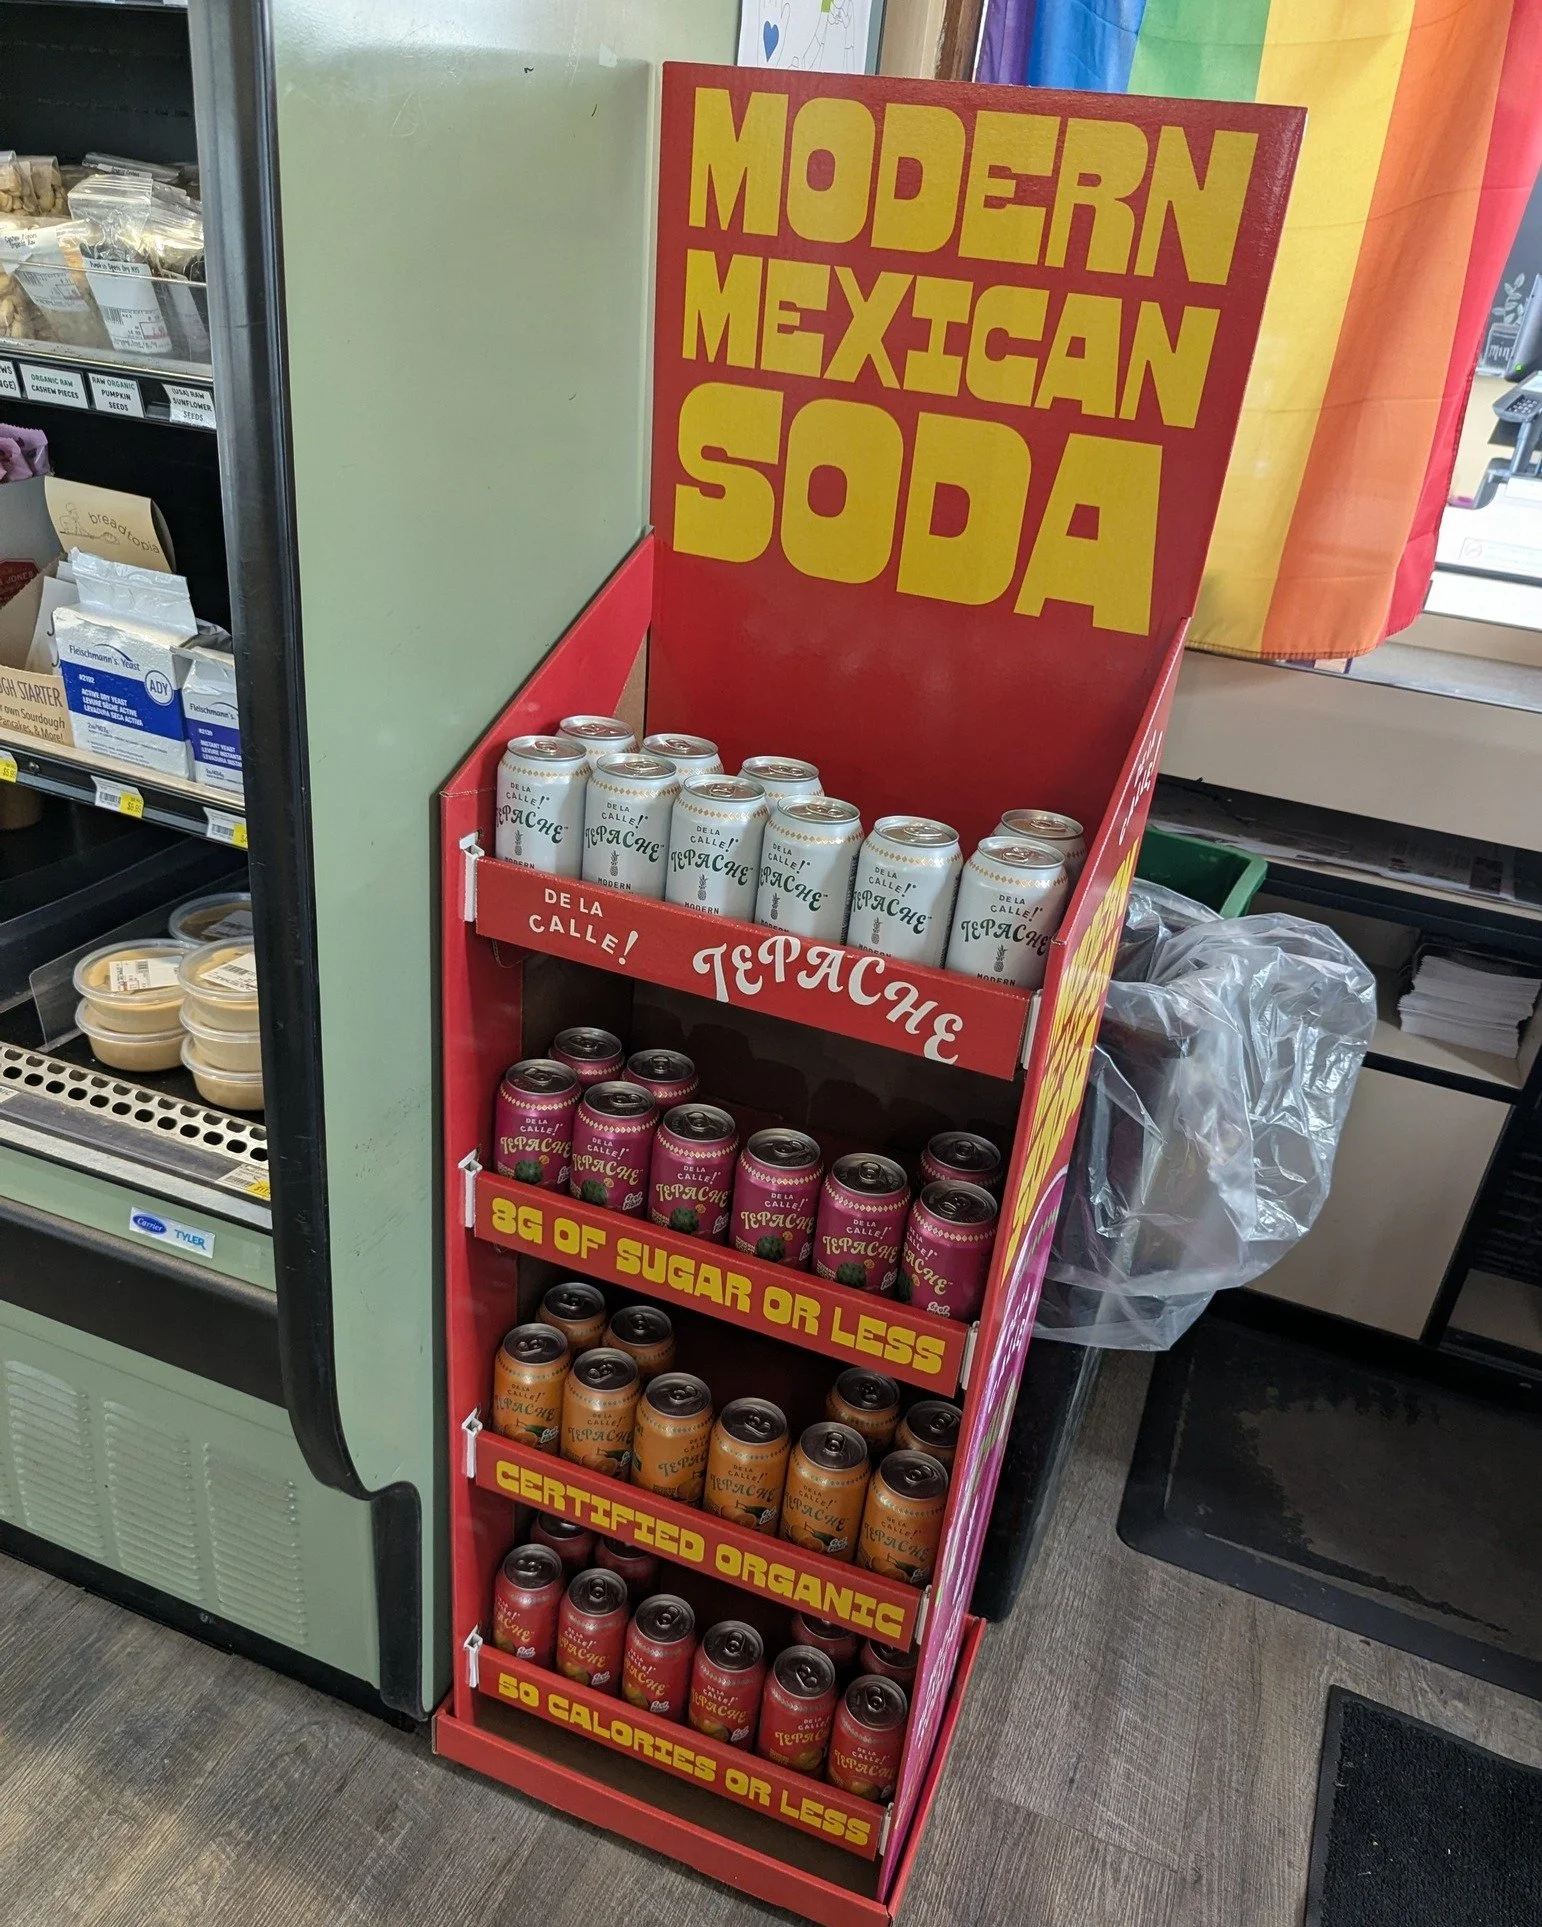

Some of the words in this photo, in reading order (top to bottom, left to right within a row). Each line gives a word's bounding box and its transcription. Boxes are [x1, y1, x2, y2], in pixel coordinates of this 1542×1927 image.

[688, 86, 1259, 286] MODERN
[681, 248, 1220, 429] MEXICAN
[31, 373, 59, 386] ORGANIC
[60, 378, 74, 388] RAW
[92, 376, 106, 386] RAW
[107, 378, 136, 391] ORGANIC
[31, 384, 57, 396] CASHEW
[57, 388, 80, 400] PIECES
[101, 389, 132, 402] PUMPKIN
[190, 390, 205, 400] RAW
[108, 401, 130, 412] SEEDS
[172, 397, 213, 412] SUNFLOWER
[183, 410, 205, 422] SEEDS
[673, 381, 1164, 637] SODA
[87, 511, 161, 555] breadtopia
[6, 570, 34, 584] JONES
[69, 644, 118, 666] Fleischmann's
[122, 658, 141, 672] Yeast
[17, 680, 63, 708] STARTER
[149, 679, 168, 696] ADY
[81, 688, 100, 699] ACTIVE
[100, 692, 111, 701] DRY
[111, 695, 128, 707] YEAST
[82, 696, 103, 708] LEVURE
[119, 706, 138, 718] ACTIVE
[83, 704, 110, 719] LEVADURA
[110, 712, 125, 721] SECA
[124, 715, 144, 727] ACTIVA
[189, 702, 236, 721] Fleischmann's
[4, 705, 20, 717] own
[20, 708, 65, 731] Sourdough
[33, 725, 41, 736] &
[41, 727, 64, 743] More!
[220, 743, 236, 753] YEAST
[510, 782, 520, 791] DE
[521, 785, 532, 793] LA
[505, 791, 546, 810] CALLE!
[606, 802, 618, 810] DE
[619, 805, 630, 813] LA
[601, 812, 644, 829] CALLE!
[696, 825, 708, 834] DE
[709, 828, 721, 836] LA
[585, 825, 660, 863] TEPACHE
[690, 835, 735, 853] CALLE!
[772, 842, 781, 852] DE
[783, 847, 792, 856] LA
[504, 856, 536, 869] MODERN
[670, 848, 749, 886] TEPACHE
[767, 852, 806, 875] CALLE!
[874, 866, 885, 876] DE
[887, 870, 898, 880] LA
[597, 877, 632, 890] MODERN
[759, 866, 822, 912] EPACHE
[868, 876, 912, 898] CALLE!
[544, 887, 572, 909] DE
[579, 897, 604, 918] LA
[684, 901, 720, 915] MODERN
[998, 894, 1012, 903] DE
[1014, 897, 1026, 905] LA
[852, 889, 926, 935] TEPACHE
[990, 904, 1039, 922] CALLE!
[528, 914, 639, 965] CALLE!
[960, 918, 1049, 957] TEPACHE
[976, 972, 1016, 987] MODERN
[692, 934, 965, 1066] TEPACHE
[519, 1123, 560, 1136] CALLE!
[525, 1117, 536, 1125] DE
[500, 1135, 572, 1159] TEPACHE
[592, 1136, 602, 1145] DE
[587, 1144, 626, 1160] CALLE!
[571, 1153, 640, 1186] TEPACHE
[677, 1171, 718, 1185] CALLE!
[655, 1183, 729, 1208] TEPACHE
[771, 1192, 782, 1200] DE
[764, 1198, 805, 1212] CALLE!
[137, 1217, 163, 1232] Carrier
[740, 1211, 815, 1235] TEPACHE
[853, 1218, 865, 1227] DE
[174, 1228, 207, 1251] TYLER
[846, 1226, 889, 1240] CALLE!
[822, 1235, 898, 1264] TEPACHE
[491, 1197, 543, 1245] 8G
[553, 1217, 607, 1260] OF
[615, 1237, 752, 1315] SUGAR
[762, 1286, 821, 1337] OR
[830, 1306, 946, 1375] LESS
[567, 1426, 633, 1444] TEPACHE
[709, 1473, 775, 1503] TEPACHE
[785, 1491, 846, 1532] TEPACHE
[495, 1459, 706, 1564] CERTIFIED
[715, 1542, 906, 1639] ORGANIC
[864, 1522, 929, 1562] TEPACHE
[498, 1672, 540, 1708] 50
[548, 1692, 717, 1783] CALORIES
[724, 1767, 773, 1807] OR
[779, 1788, 872, 1846] LESS
